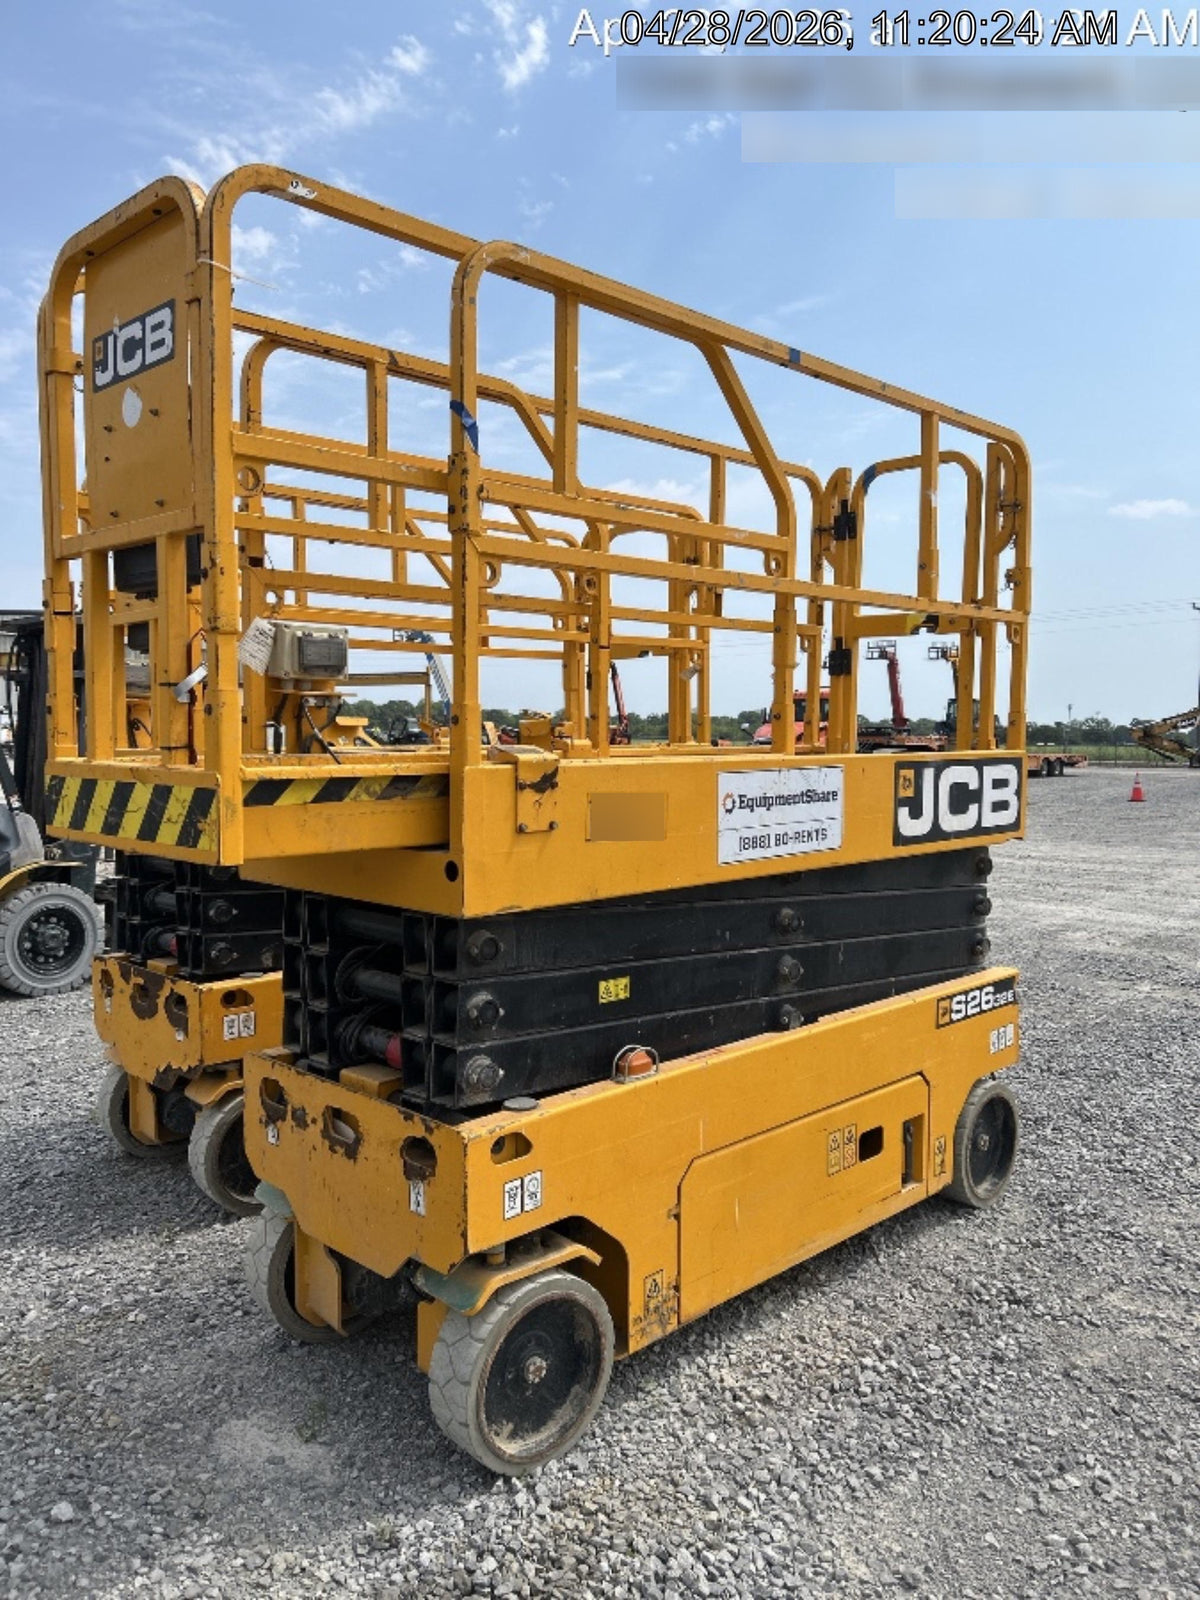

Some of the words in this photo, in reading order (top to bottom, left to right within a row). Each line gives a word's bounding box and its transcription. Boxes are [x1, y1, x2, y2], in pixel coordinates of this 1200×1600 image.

[95, 307, 173, 386] JCB
[737, 789, 839, 813] EquipmentShare
[897, 764, 1019, 837] JCB
